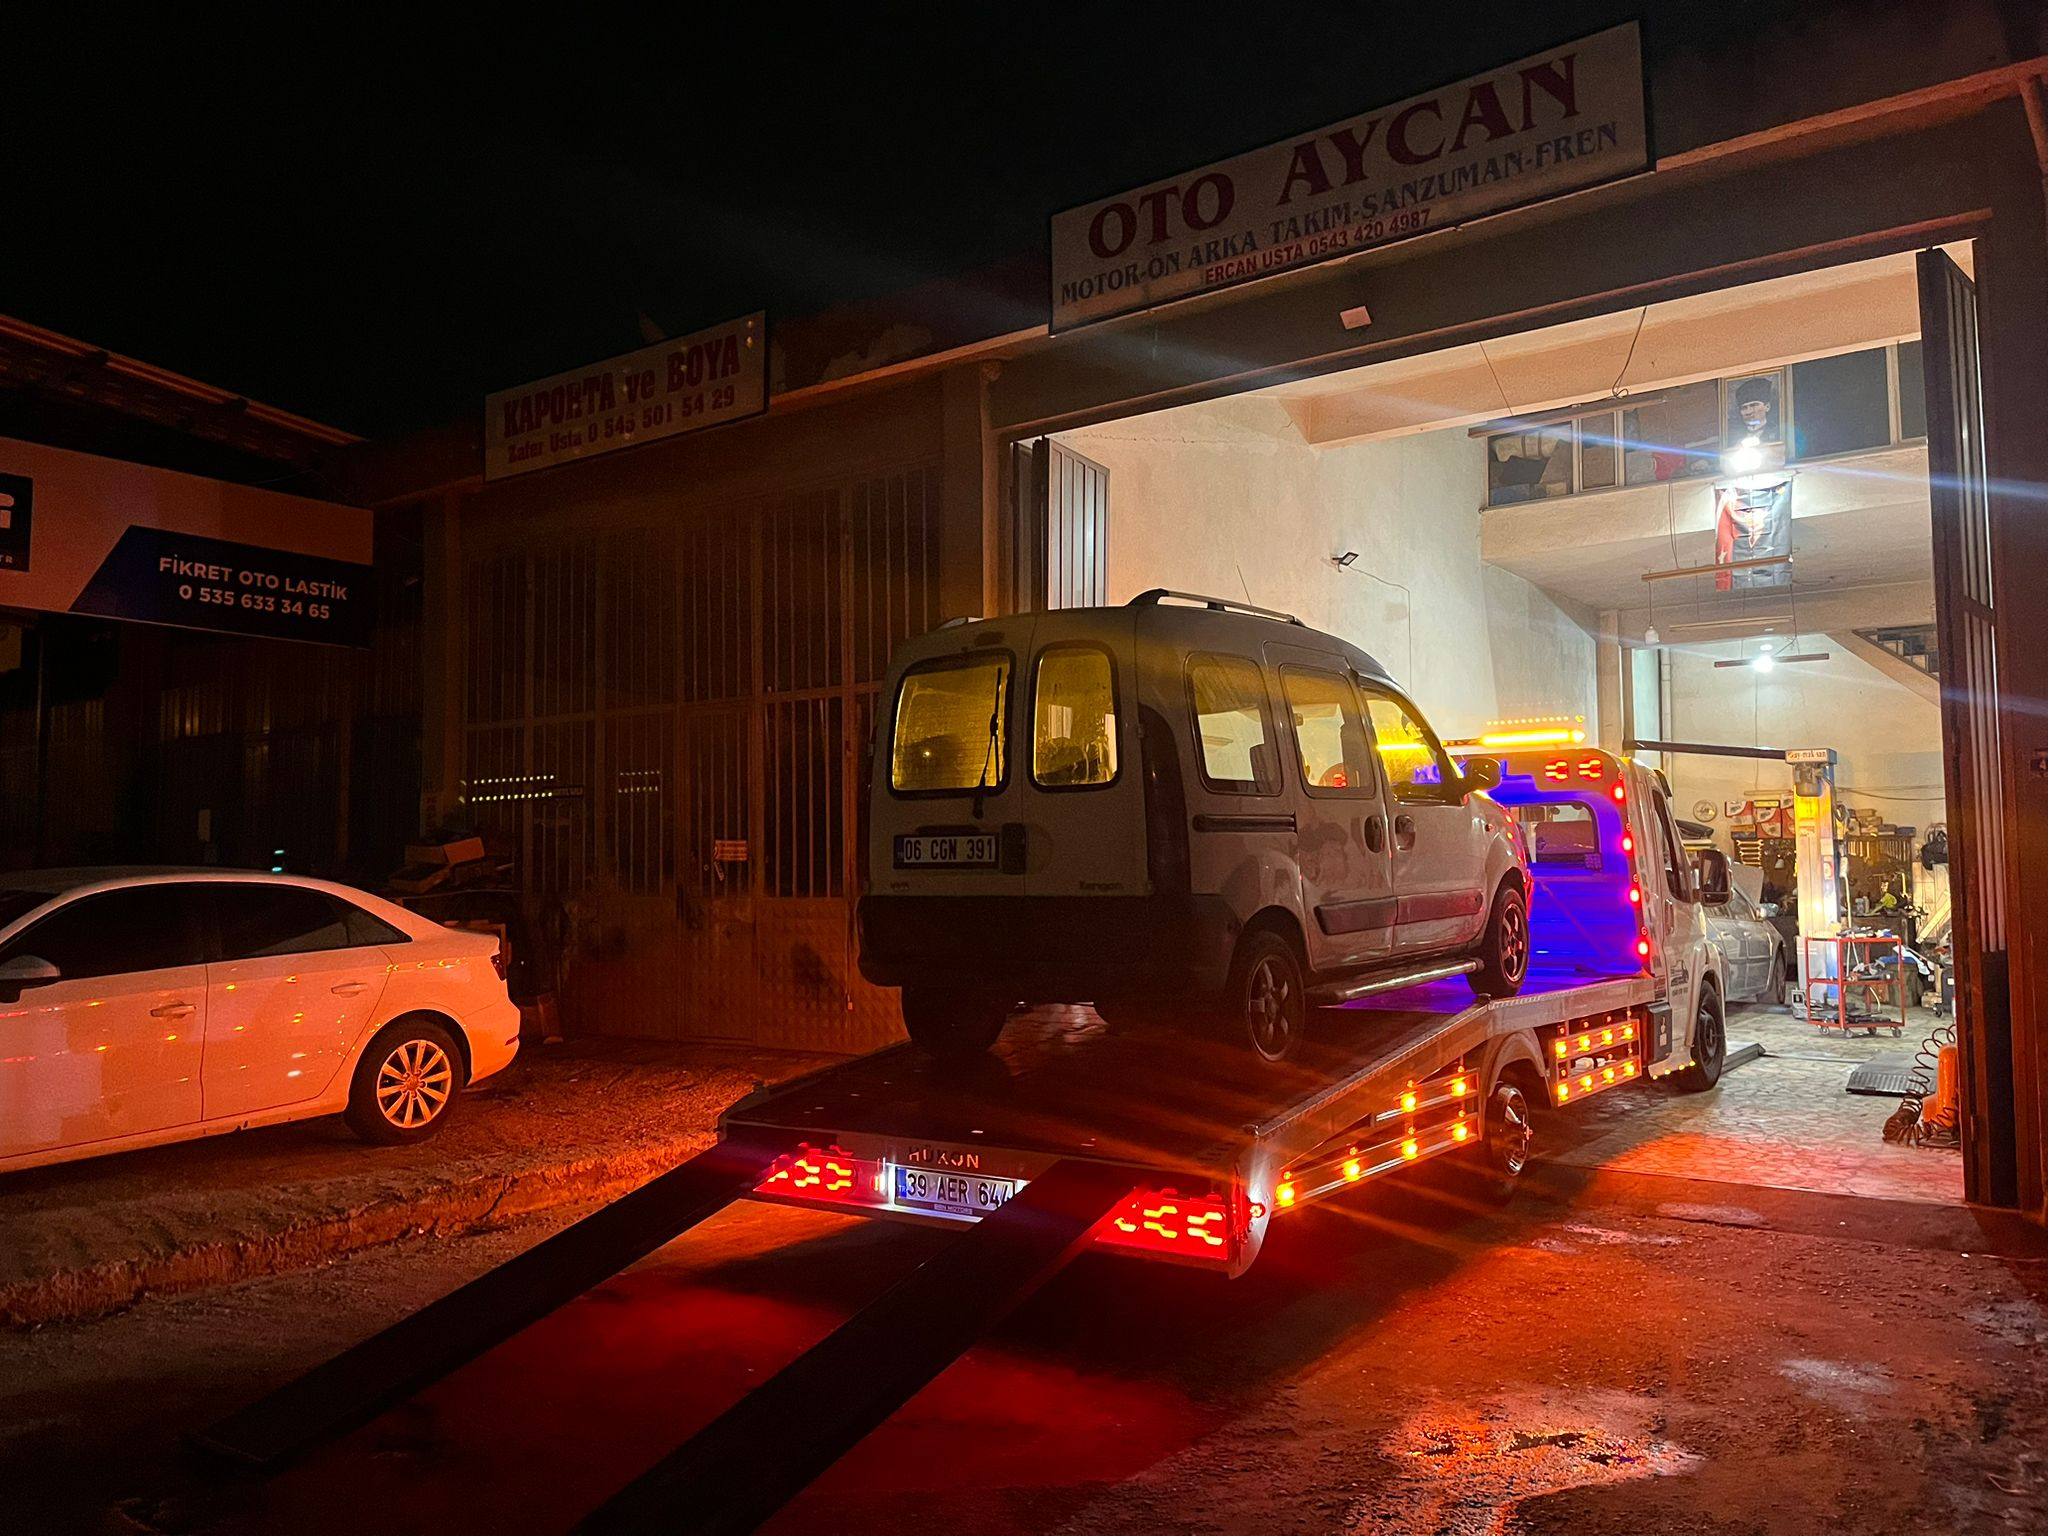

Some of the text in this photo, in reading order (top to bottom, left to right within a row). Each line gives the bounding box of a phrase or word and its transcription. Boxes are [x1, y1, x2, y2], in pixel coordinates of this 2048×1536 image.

[1088, 53, 1580, 258] OTO AYCAN
[1061, 251, 1181, 305] MOTOR-ÖN
[1188, 230, 1257, 268] ARKA
[1206, 208, 1431, 285] ERCAN USTA 0543 420 4987
[504, 334, 741, 438] KAPORTA ve BOYA
[549, 429, 582, 452] Usta
[588, 422, 598, 443] 0
[642, 403, 672, 429] 501
[682, 393, 705, 418] 54
[712, 385, 735, 410] 29
[159, 554, 348, 601] FİKRET OTO LASTİK
[179, 586, 330, 620] 0 535 633 34 65
[905, 838, 993, 860] 06 CGN 391
[907, 1173, 927, 1197] 39
[937, 1176, 968, 1204] AER
